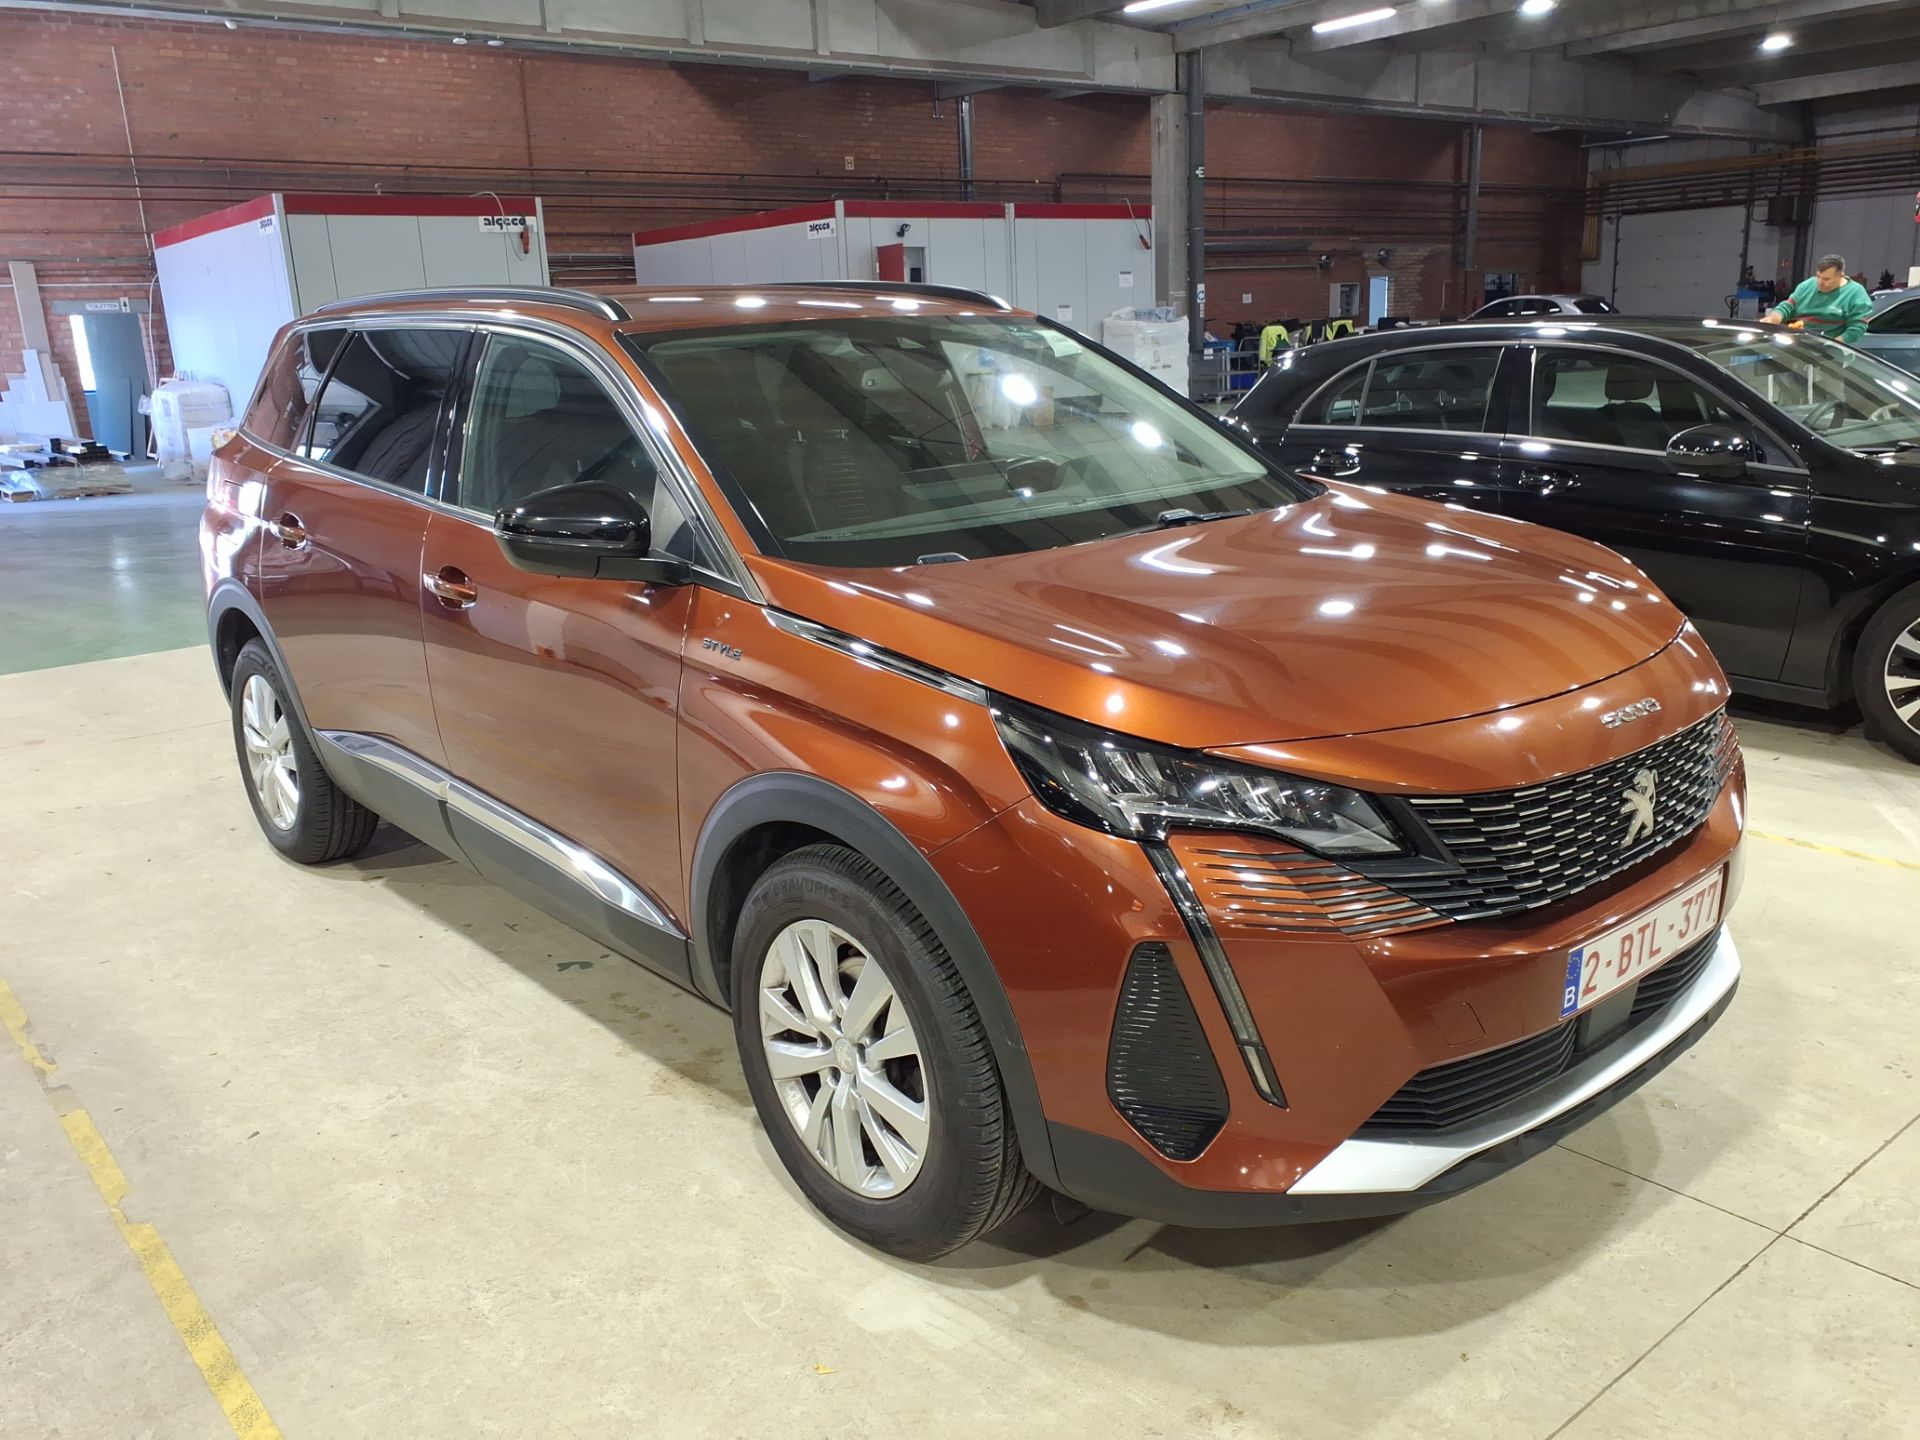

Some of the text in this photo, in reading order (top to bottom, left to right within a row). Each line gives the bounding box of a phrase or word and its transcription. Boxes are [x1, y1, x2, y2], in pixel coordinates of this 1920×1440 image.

[703, 636, 743, 660] STYLE
[1600, 697, 1662, 728] 5008
[1582, 880, 1719, 997] 2-BTL-377
[1564, 985, 1576, 1009] B
